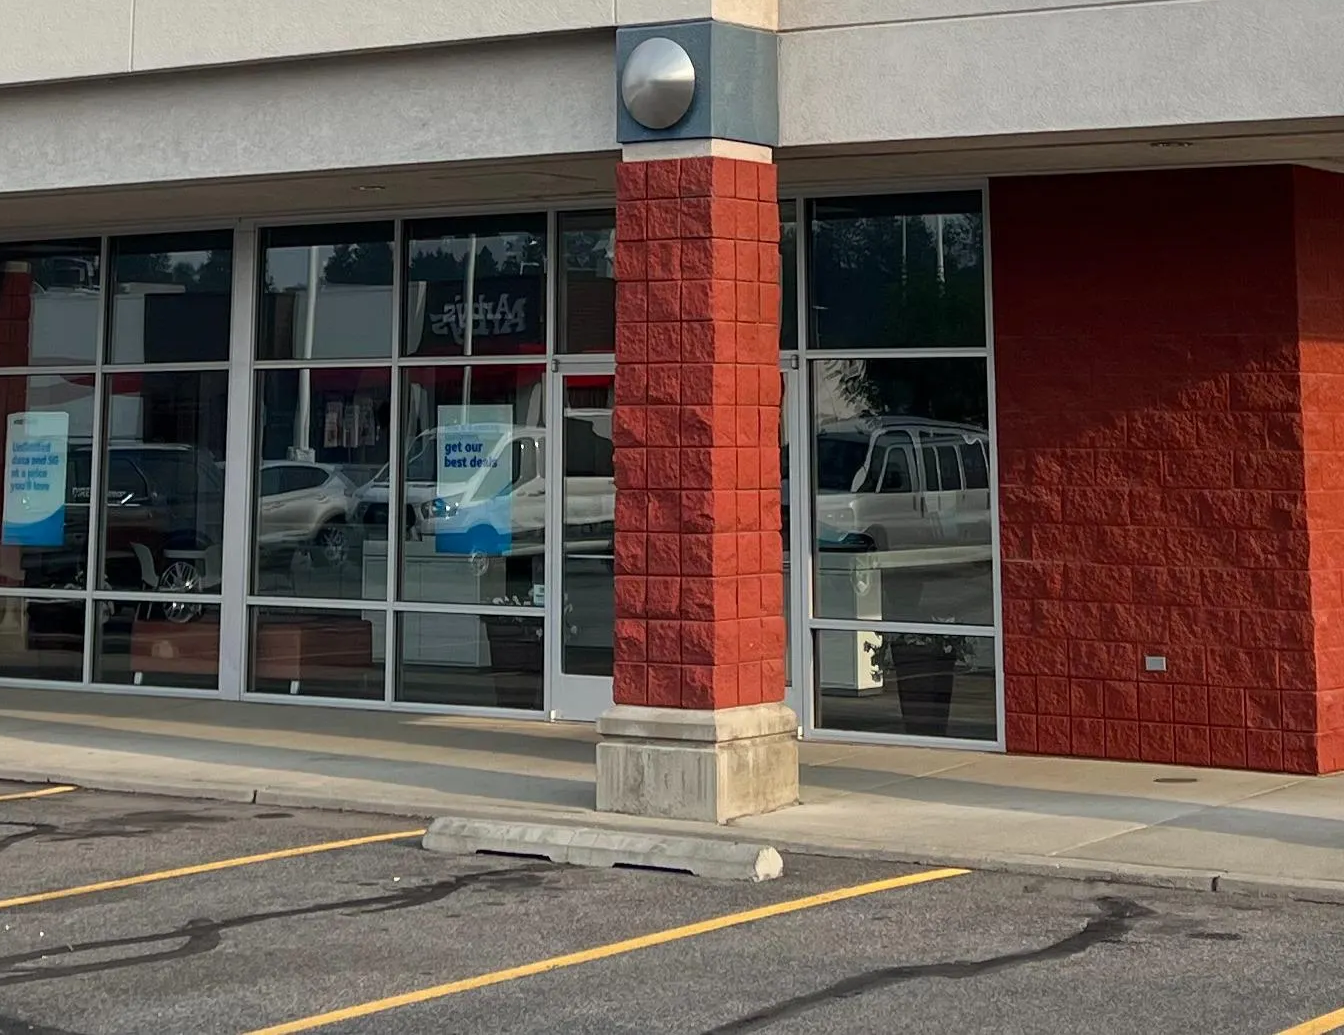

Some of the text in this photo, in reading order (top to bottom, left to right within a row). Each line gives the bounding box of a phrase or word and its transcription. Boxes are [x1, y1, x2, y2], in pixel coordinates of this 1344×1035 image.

[445, 442, 483, 455] get our
[444, 456, 467, 467] best
